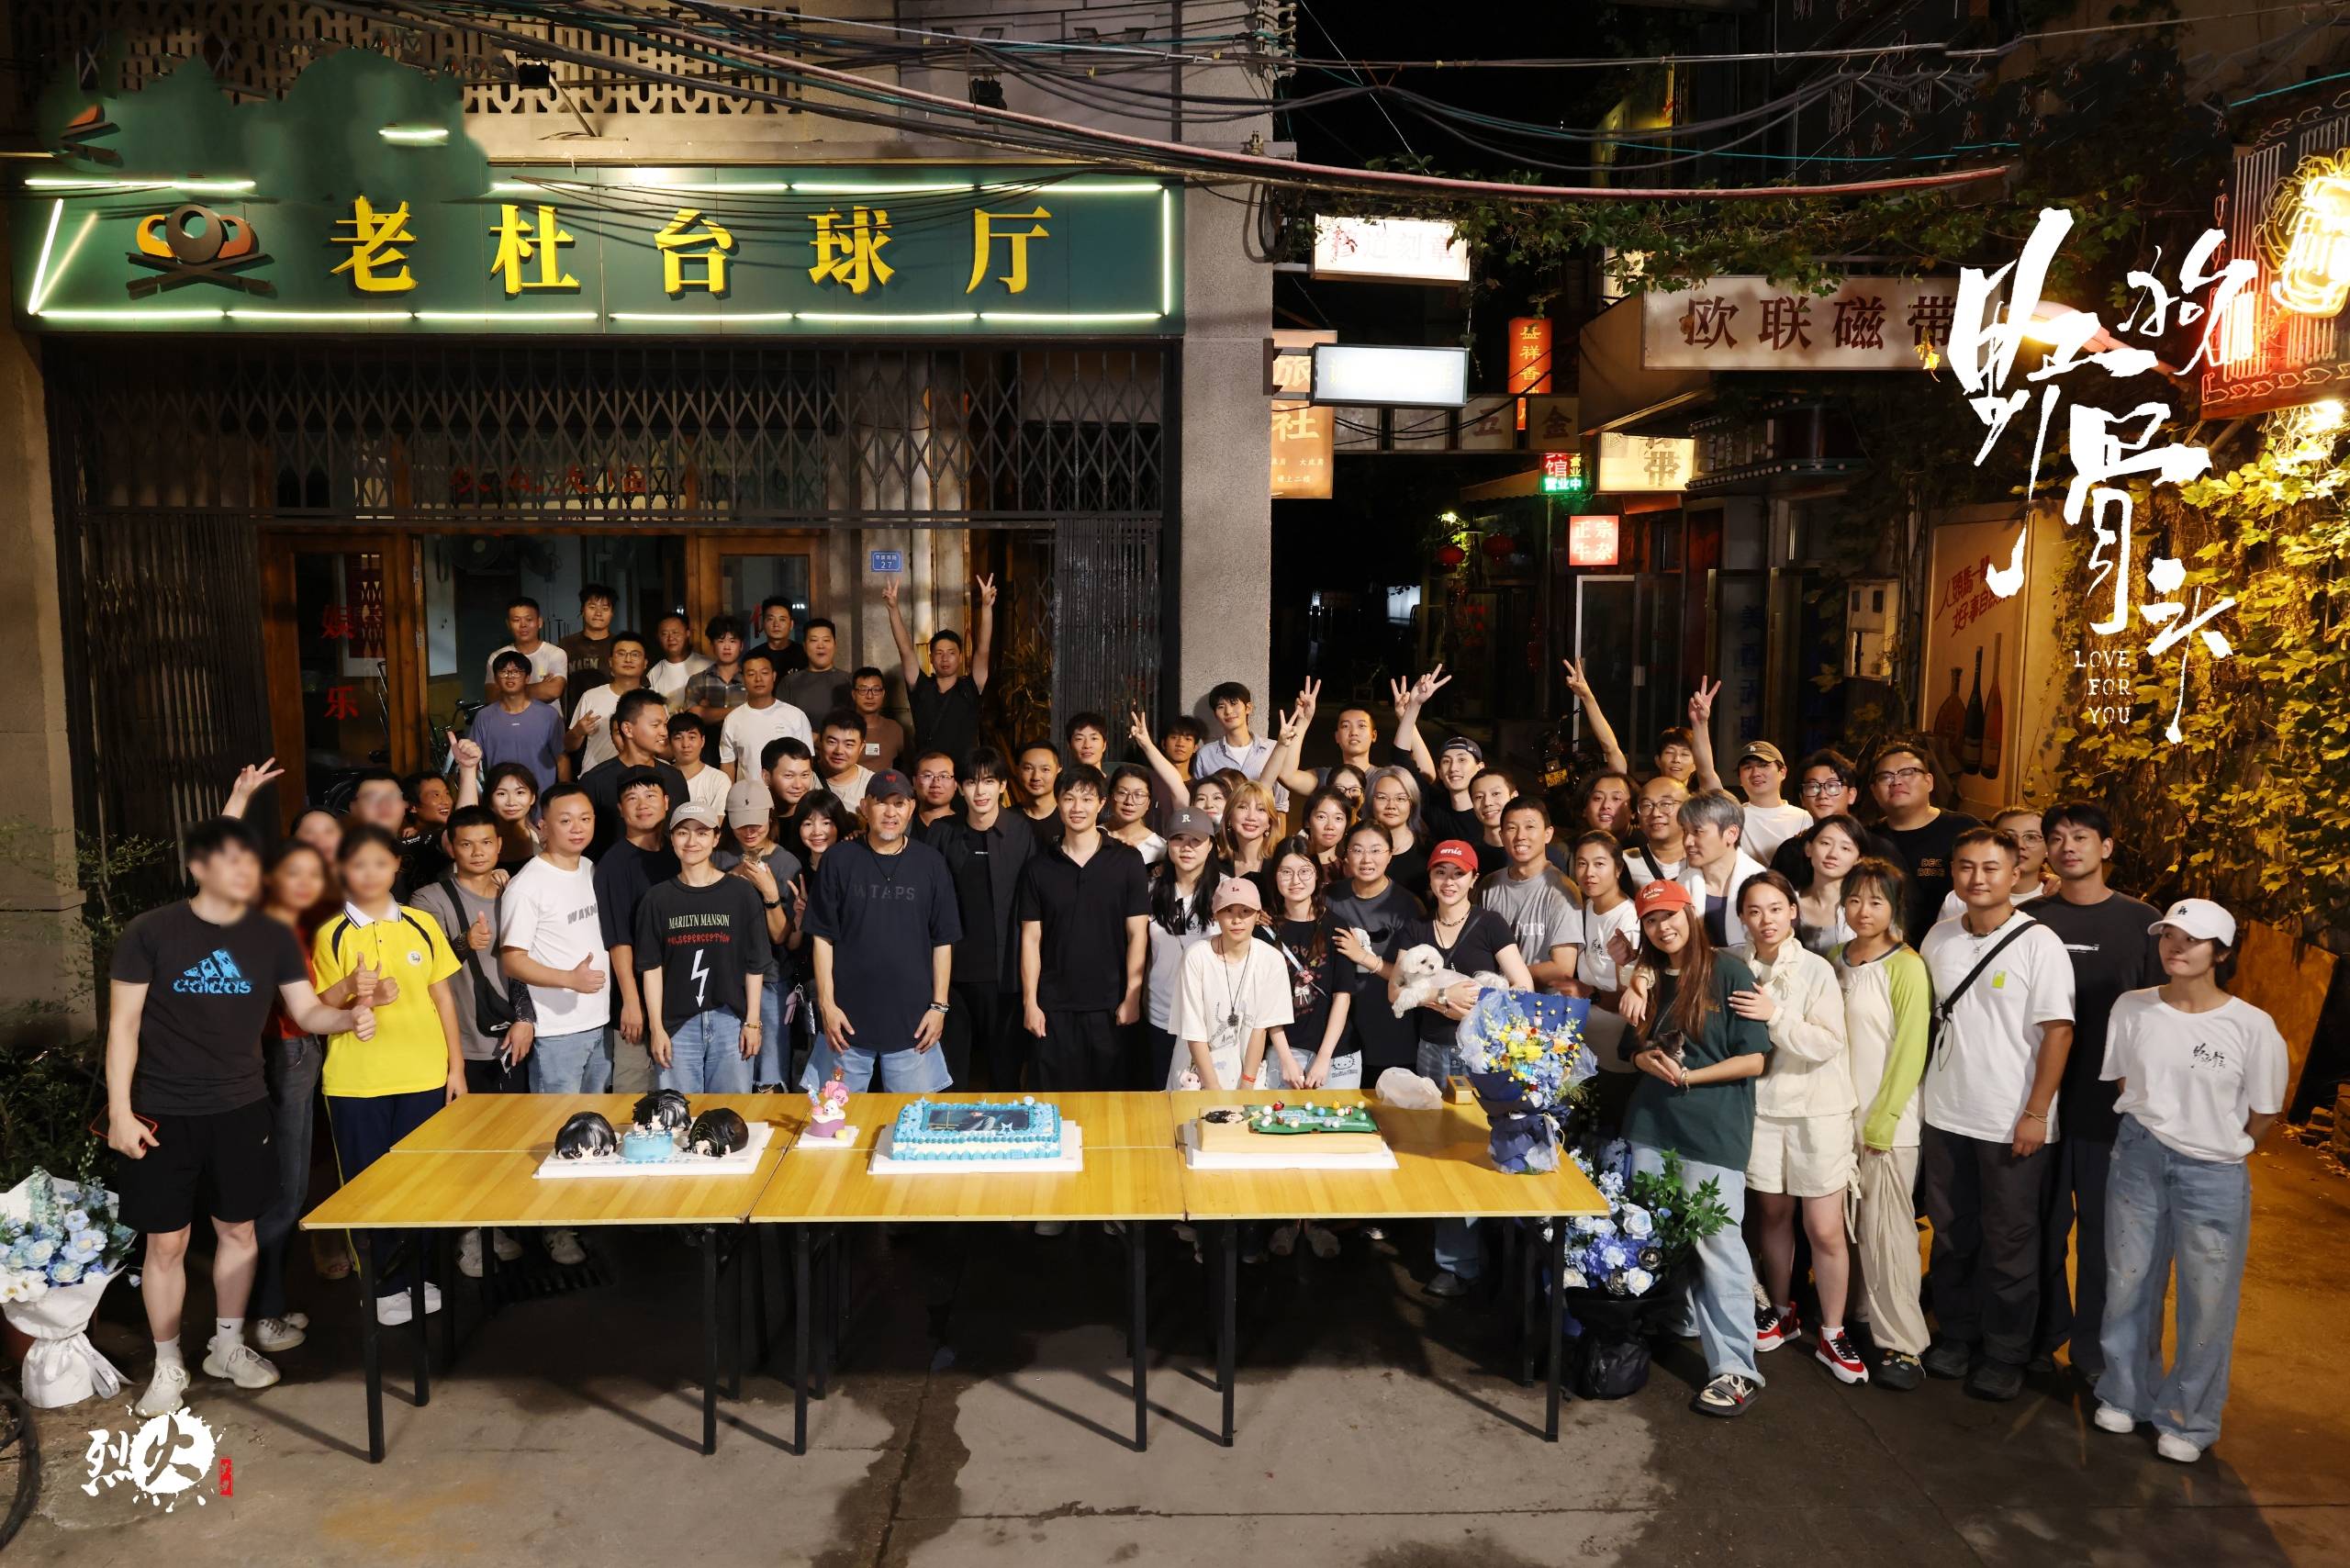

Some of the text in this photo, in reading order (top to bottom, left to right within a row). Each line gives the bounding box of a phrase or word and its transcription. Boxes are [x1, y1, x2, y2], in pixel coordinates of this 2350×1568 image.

[330, 195, 1053, 296] 老杜台球厅
[1684, 296, 1957, 351] 欧联磁带
[1573, 521, 1613, 538] 正宗
[319, 603, 359, 721] 娱乐
[1181, 813, 1192, 823] R
[1440, 846, 1462, 856] emis
[854, 884, 916, 902] WTAPS
[668, 913, 731, 930] MARILYN MANSON
[173, 976, 252, 995] adidas
